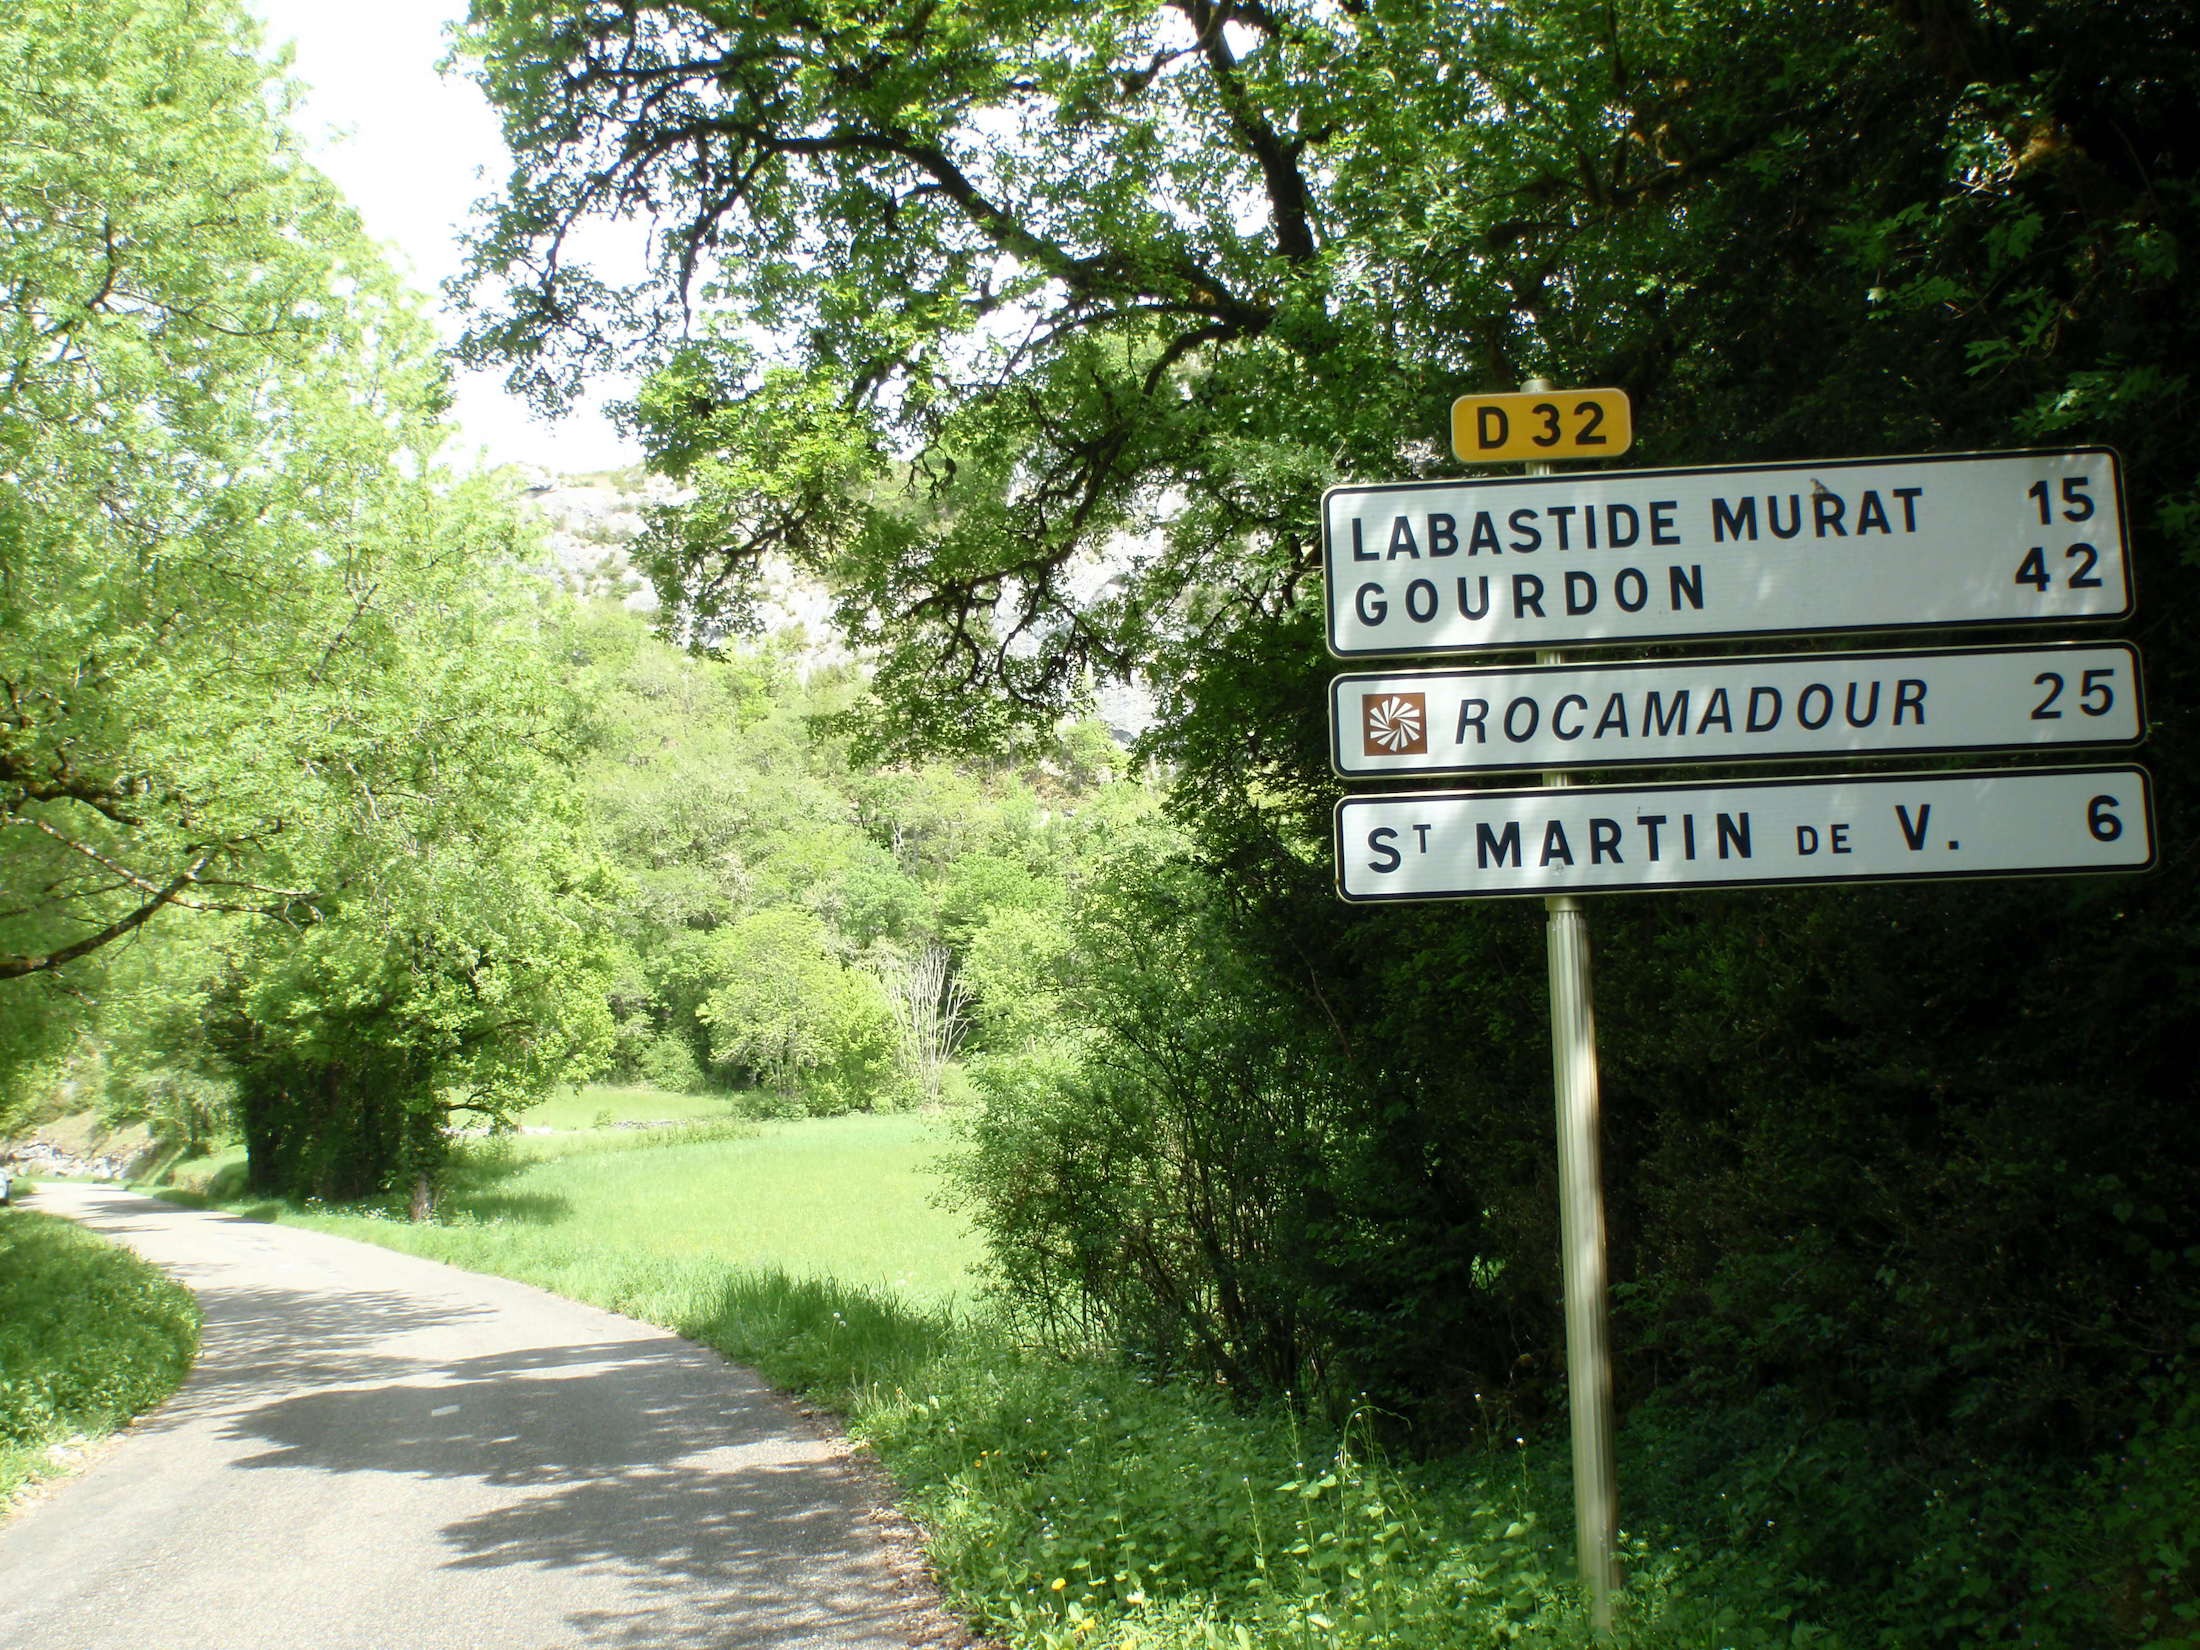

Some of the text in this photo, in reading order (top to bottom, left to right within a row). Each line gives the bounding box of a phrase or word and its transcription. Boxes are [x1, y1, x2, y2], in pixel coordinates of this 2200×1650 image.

[1477, 401, 1607, 450] D 32
[1351, 476, 2096, 562] LABASTIDE MURAT 15
[1355, 543, 2103, 627] GOURDON 42
[1455, 668, 2115, 745] ROCAMADOUR 25
[1475, 812, 1752, 869] MARTIN
[1796, 824, 1852, 856] DE
[1895, 804, 1960, 851] V.
[2087, 795, 2123, 842] 6
